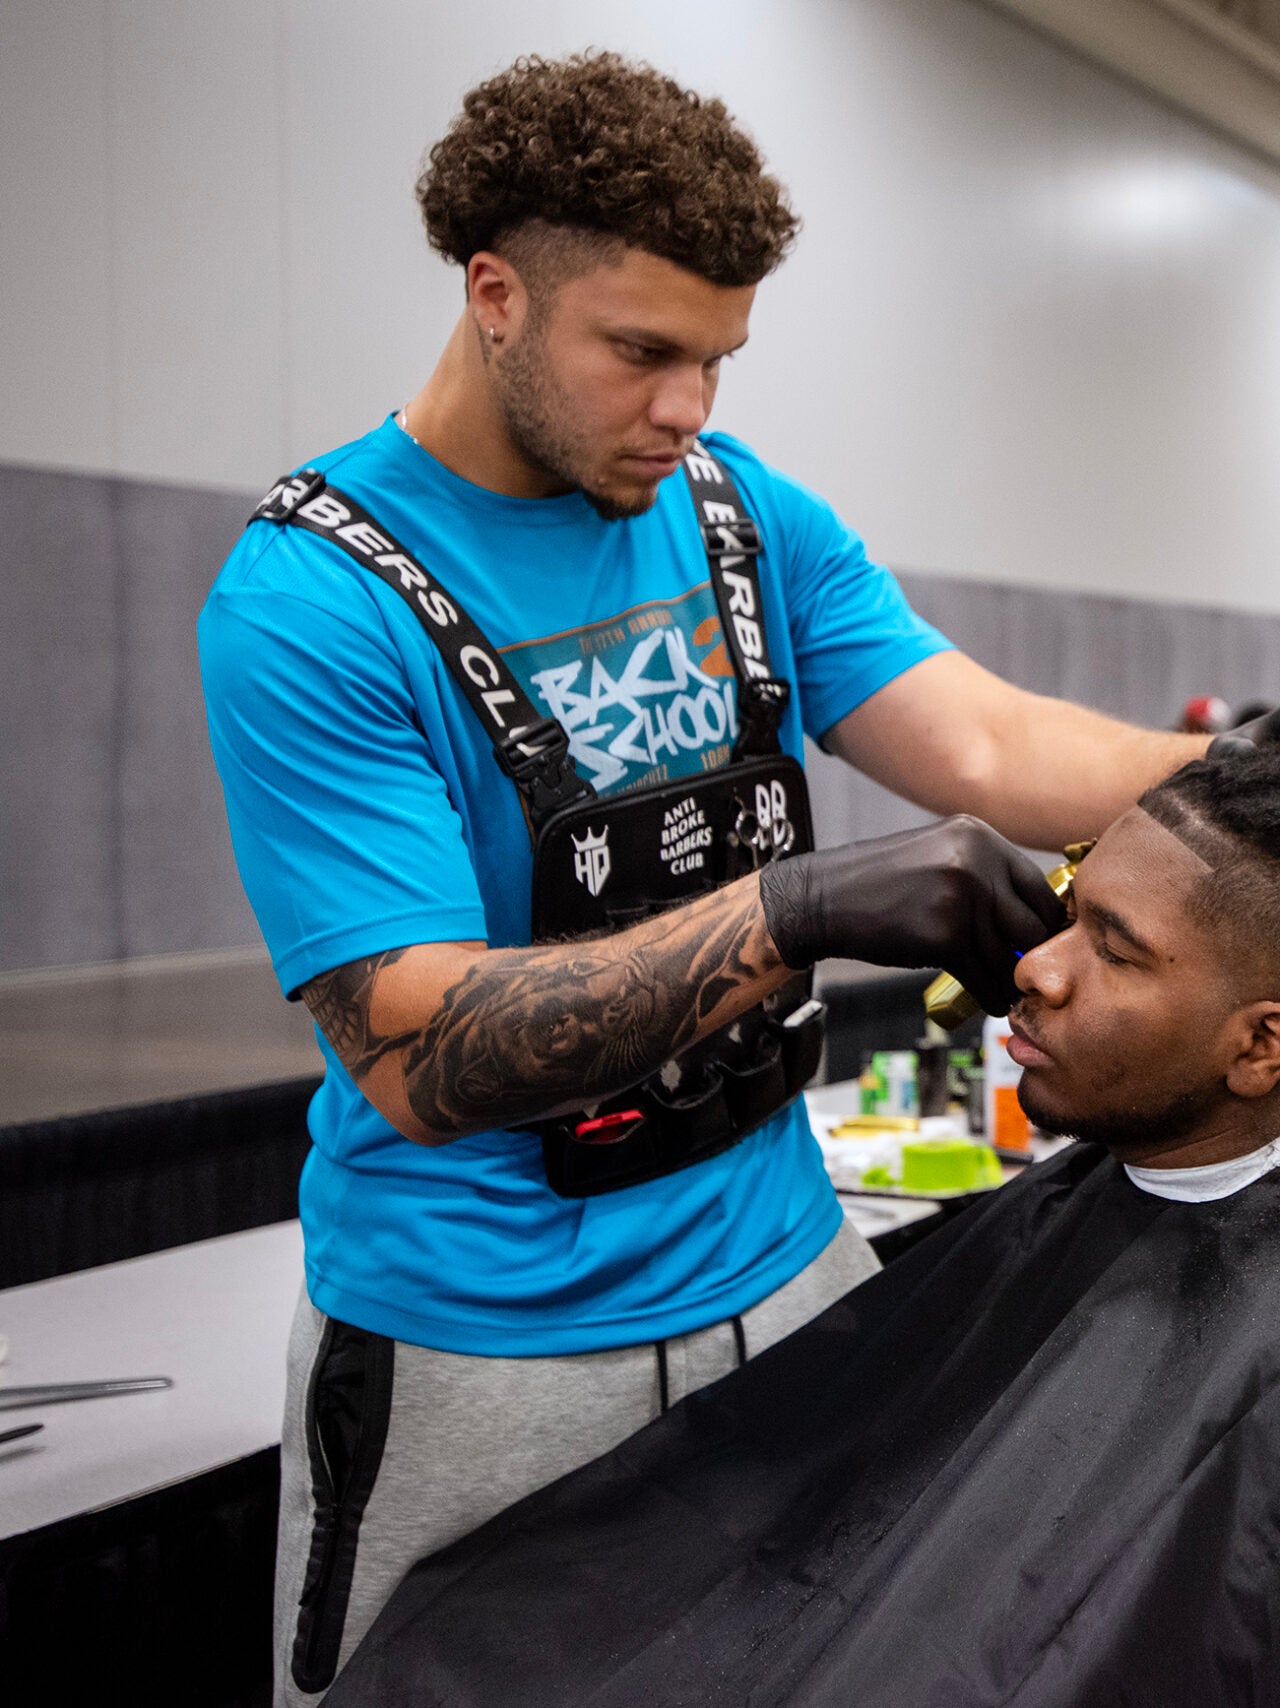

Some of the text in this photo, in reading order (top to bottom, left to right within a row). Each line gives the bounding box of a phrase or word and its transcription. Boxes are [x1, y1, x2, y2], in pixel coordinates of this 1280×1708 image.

[531, 627, 720, 730] BACK
[661, 810, 706, 845] BROKE
[664, 797, 697, 827] ANTI
[660, 826, 713, 861] BARBERS
[670, 852, 704, 875] CLUB
